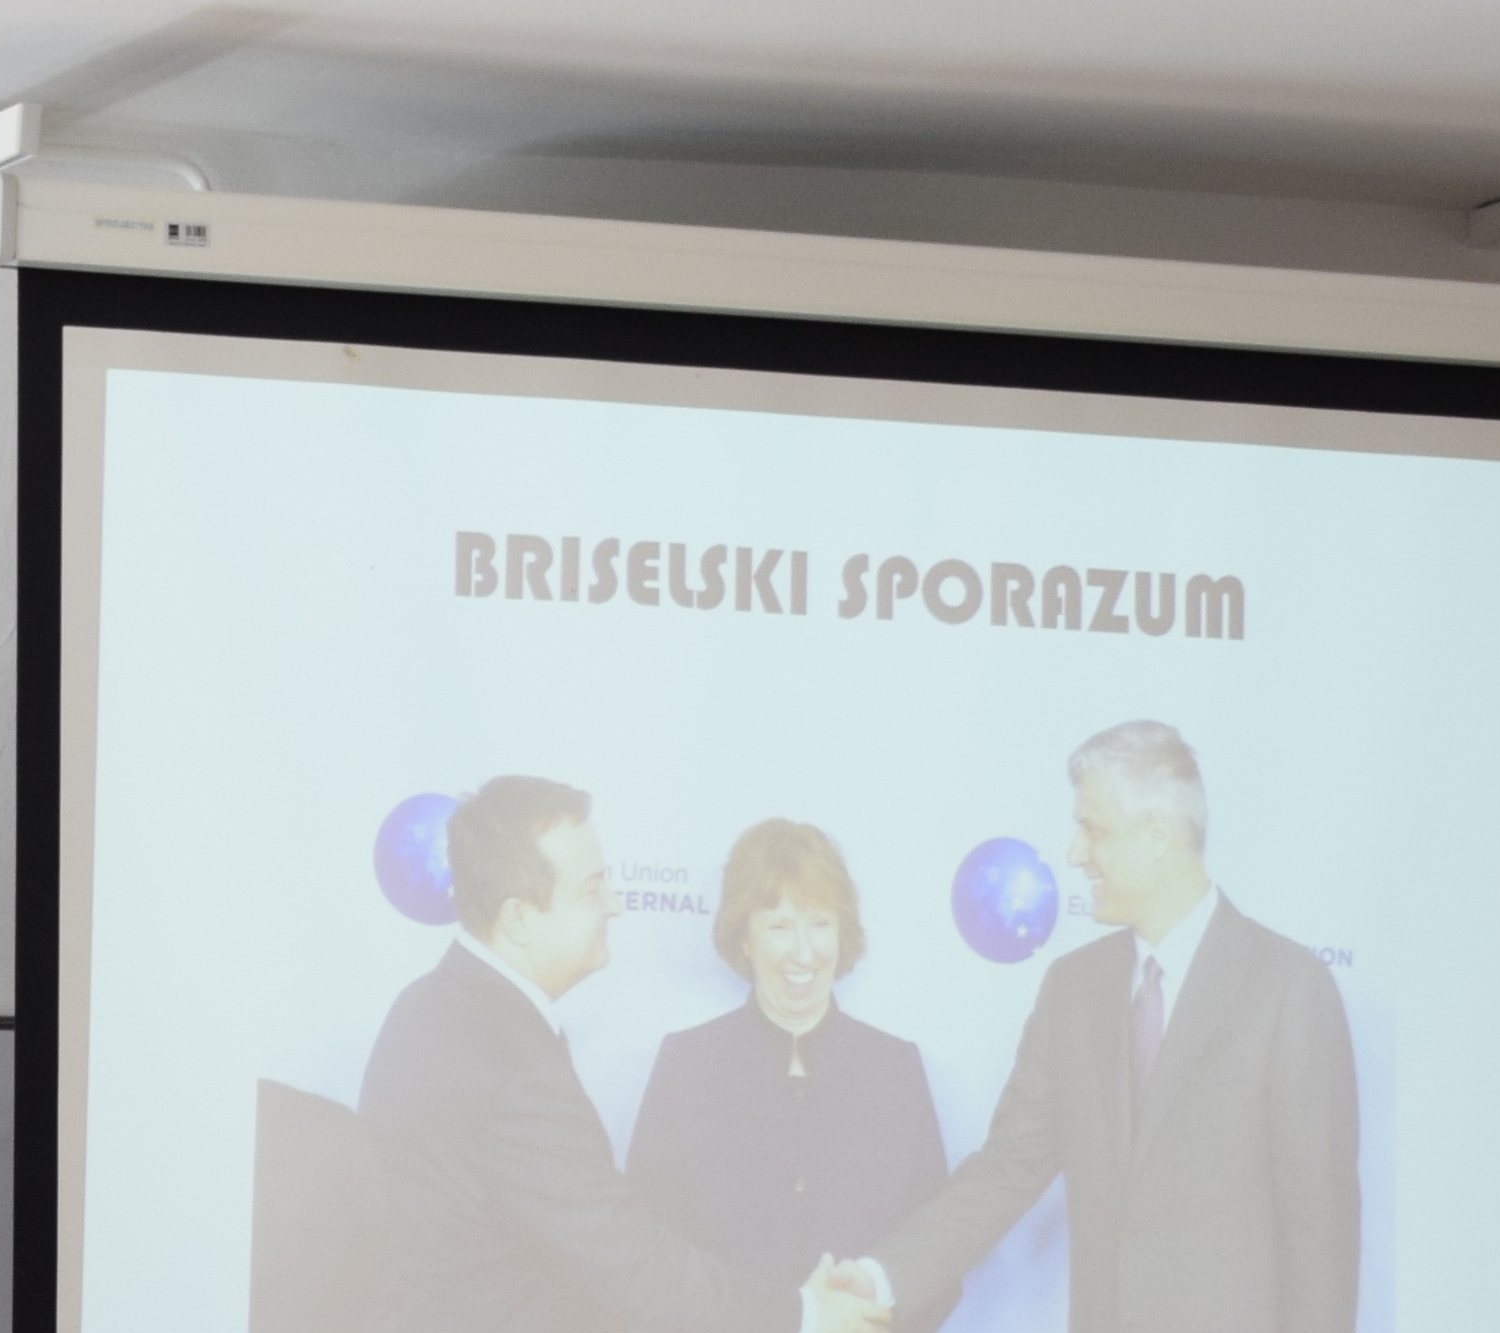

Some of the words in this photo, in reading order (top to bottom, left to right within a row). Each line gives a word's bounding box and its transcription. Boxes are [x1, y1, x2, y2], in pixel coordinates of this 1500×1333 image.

[454, 530, 809, 616] BRISELSKI
[838, 553, 1246, 641] SPORAZUM
[621, 861, 689, 884] Union
[615, 889, 710, 915] ERNAL
